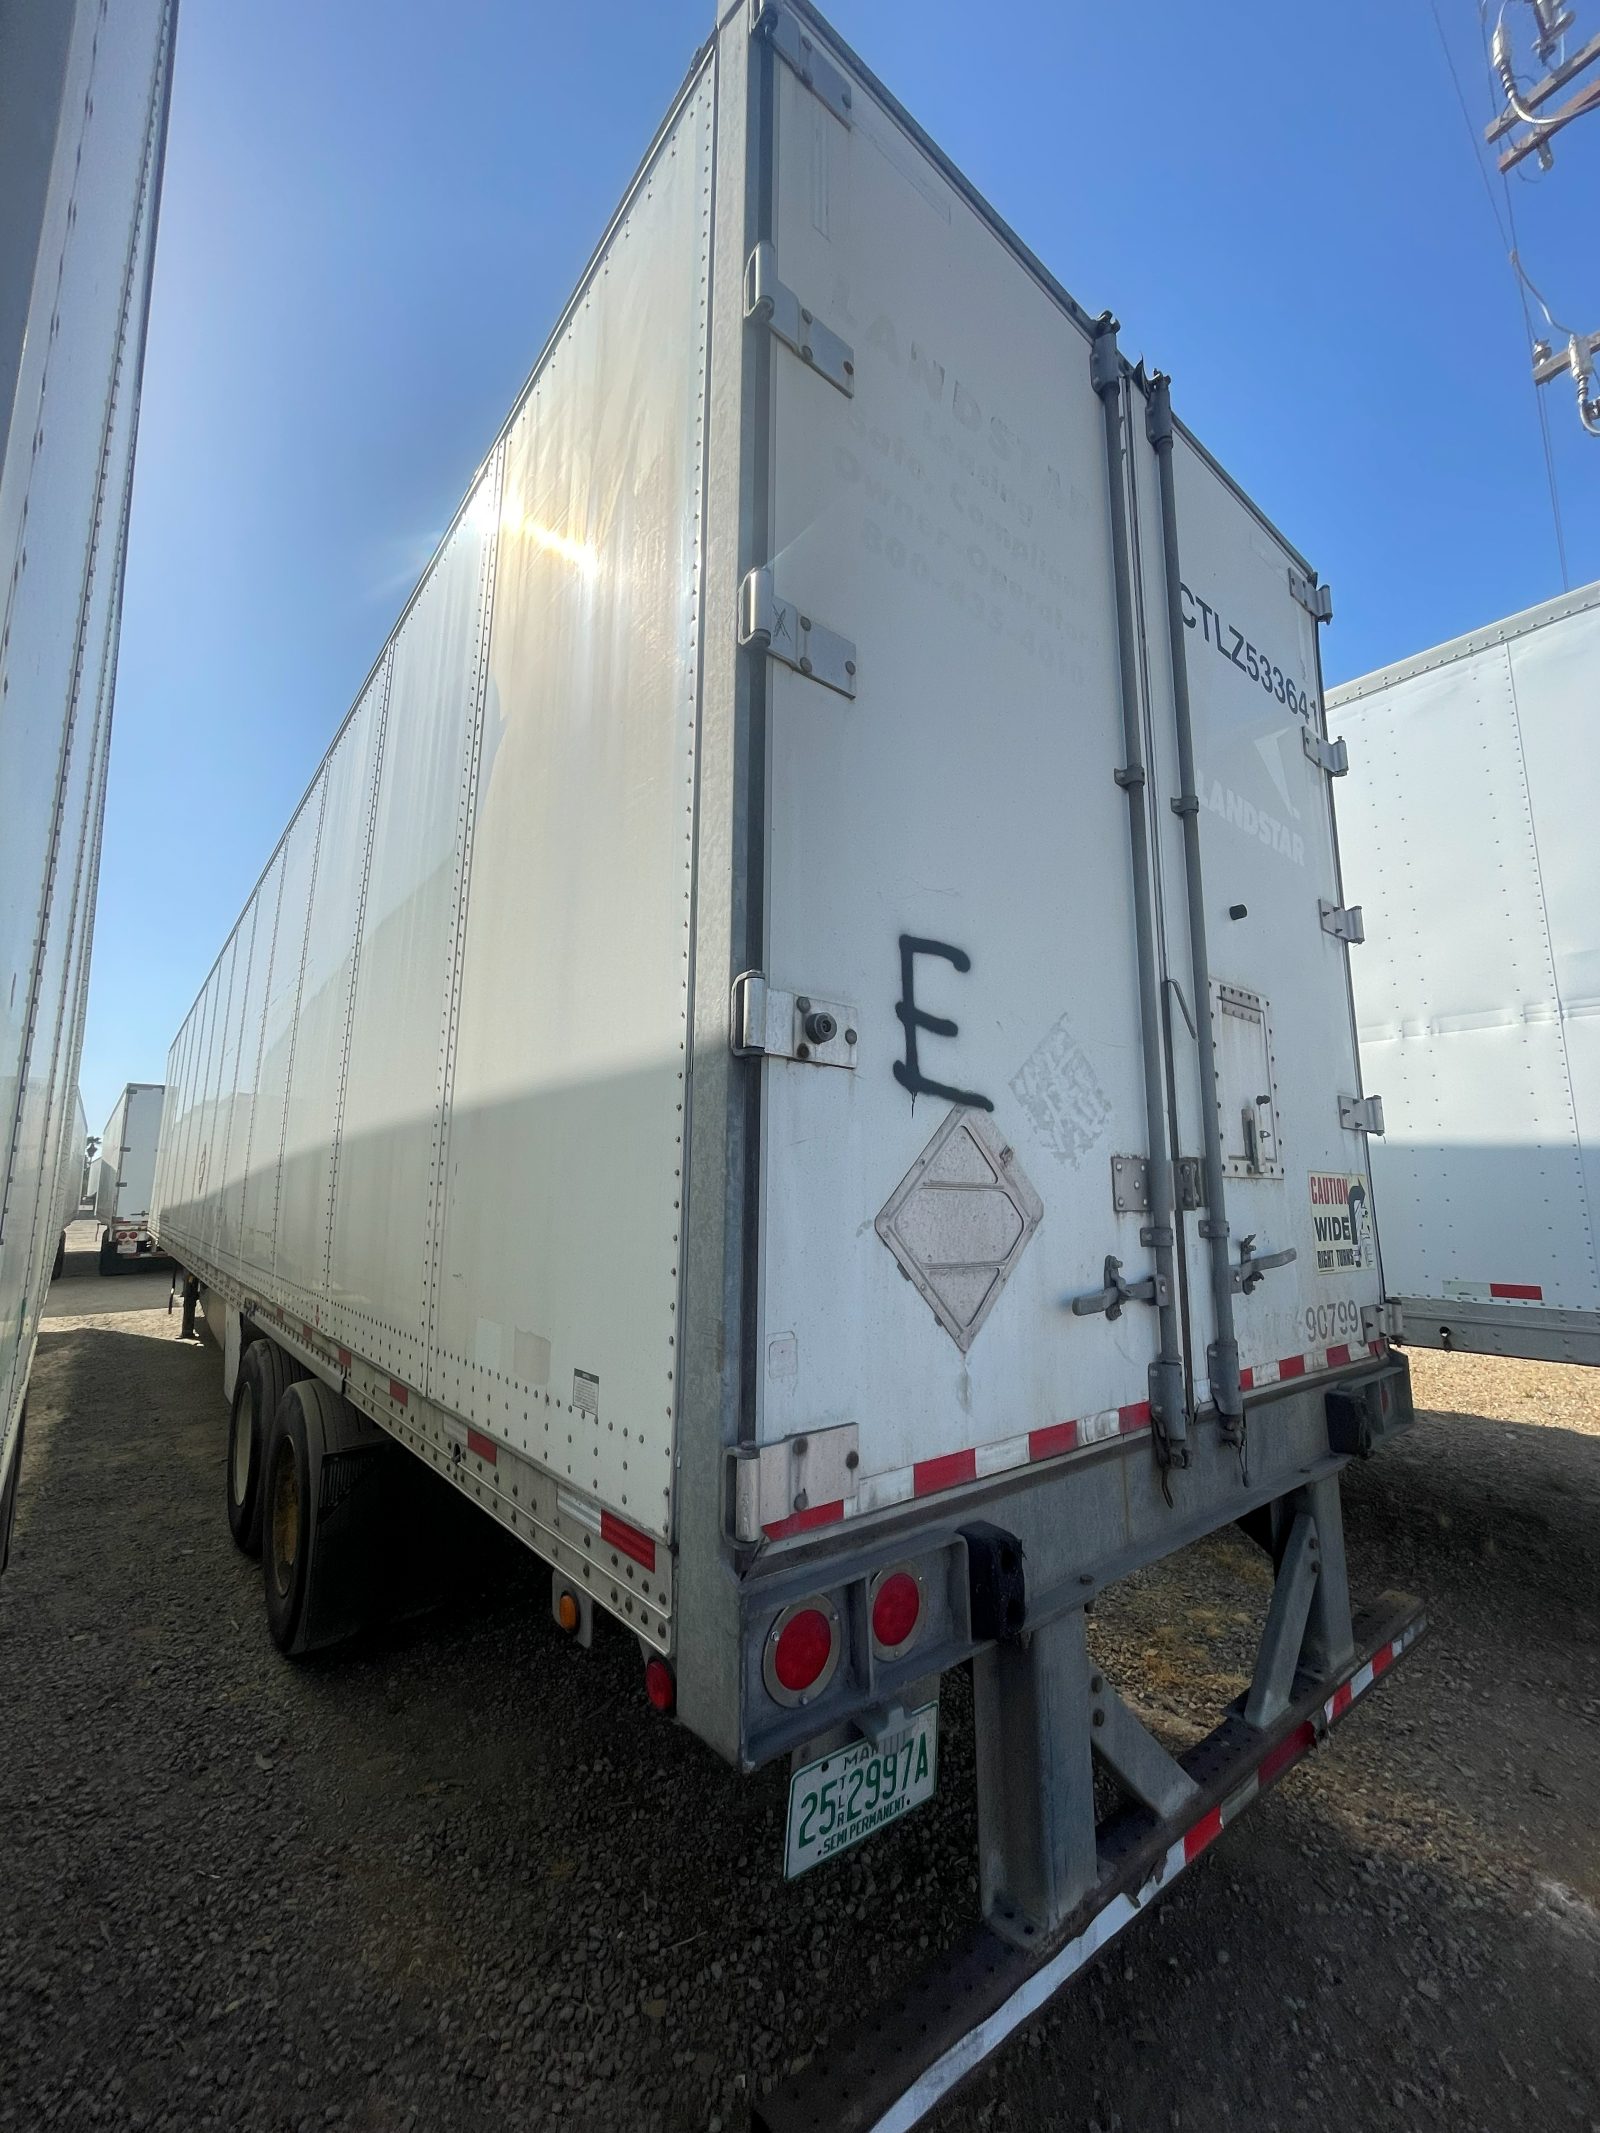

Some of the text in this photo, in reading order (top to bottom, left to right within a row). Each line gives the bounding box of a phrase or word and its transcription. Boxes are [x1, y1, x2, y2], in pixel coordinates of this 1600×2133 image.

[1179, 581, 1318, 733] CTLZ533641
[1196, 768, 1306, 867] LANDSTAR
[893, 934, 994, 1113] E
[1309, 1176, 1350, 1205] CAUTION
[1313, 1216, 1351, 1242] WIDE
[1317, 1249, 1354, 1268] RIGHT TURNS
[1305, 1299, 1359, 1343] 90799
[823, 1793, 906, 1854] SEMI PERMANENT
